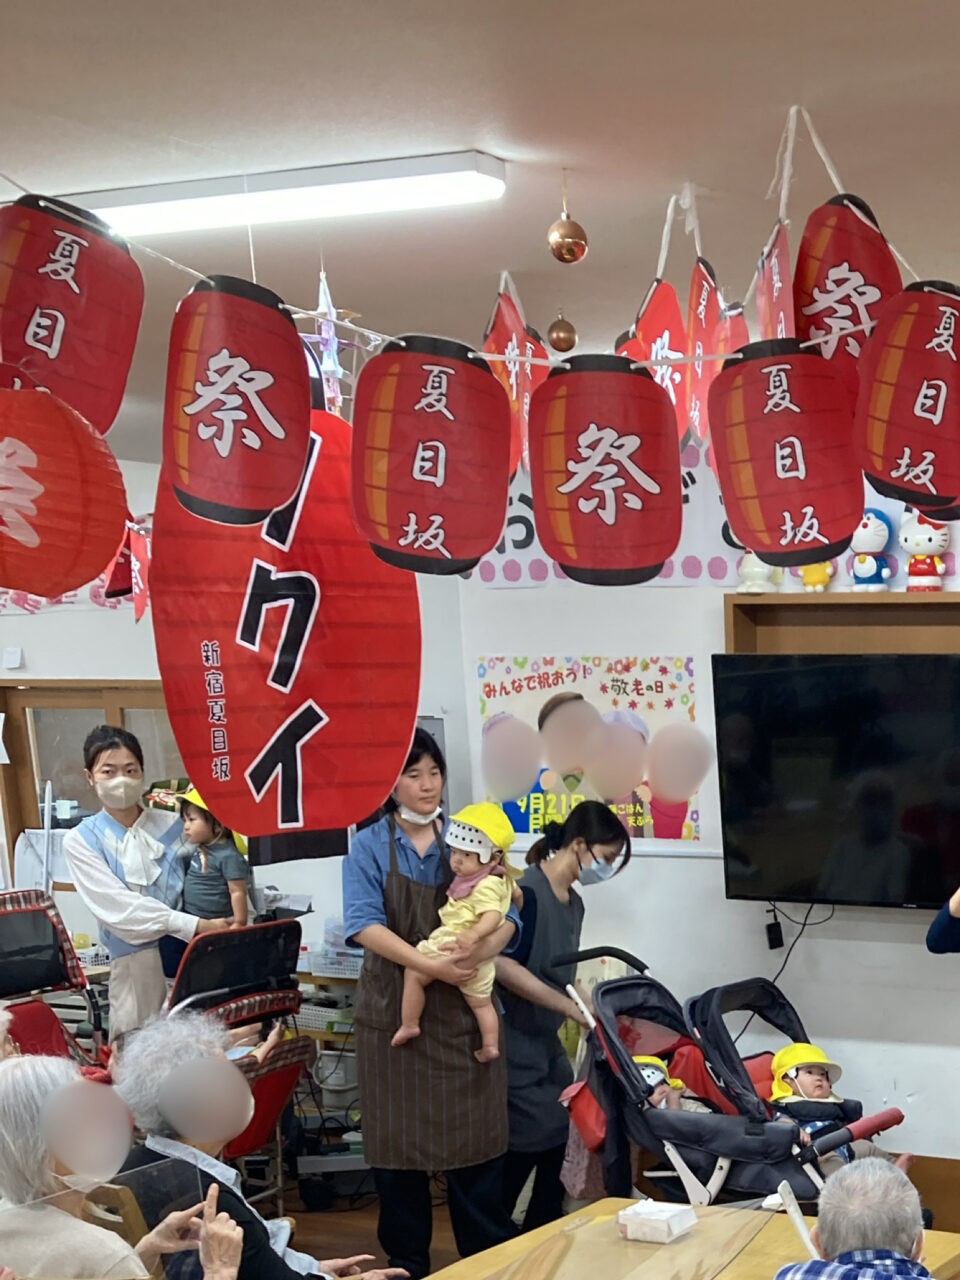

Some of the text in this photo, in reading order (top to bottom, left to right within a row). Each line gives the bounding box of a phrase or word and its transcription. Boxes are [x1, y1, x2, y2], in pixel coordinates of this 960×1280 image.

[12, 229, 90, 391] 夏目
[802, 262, 882, 360] 祭
[182, 347, 287, 459] 祭
[398, 363, 458, 559] 夏目坂
[759, 363, 831, 545] 夏目坂
[889, 305, 958, 495] 夏目坂
[556, 423, 662, 526] 祭
[201, 640, 231, 781] 新宿夏目坂
[610, 678, 664, 697] 敬老の日
